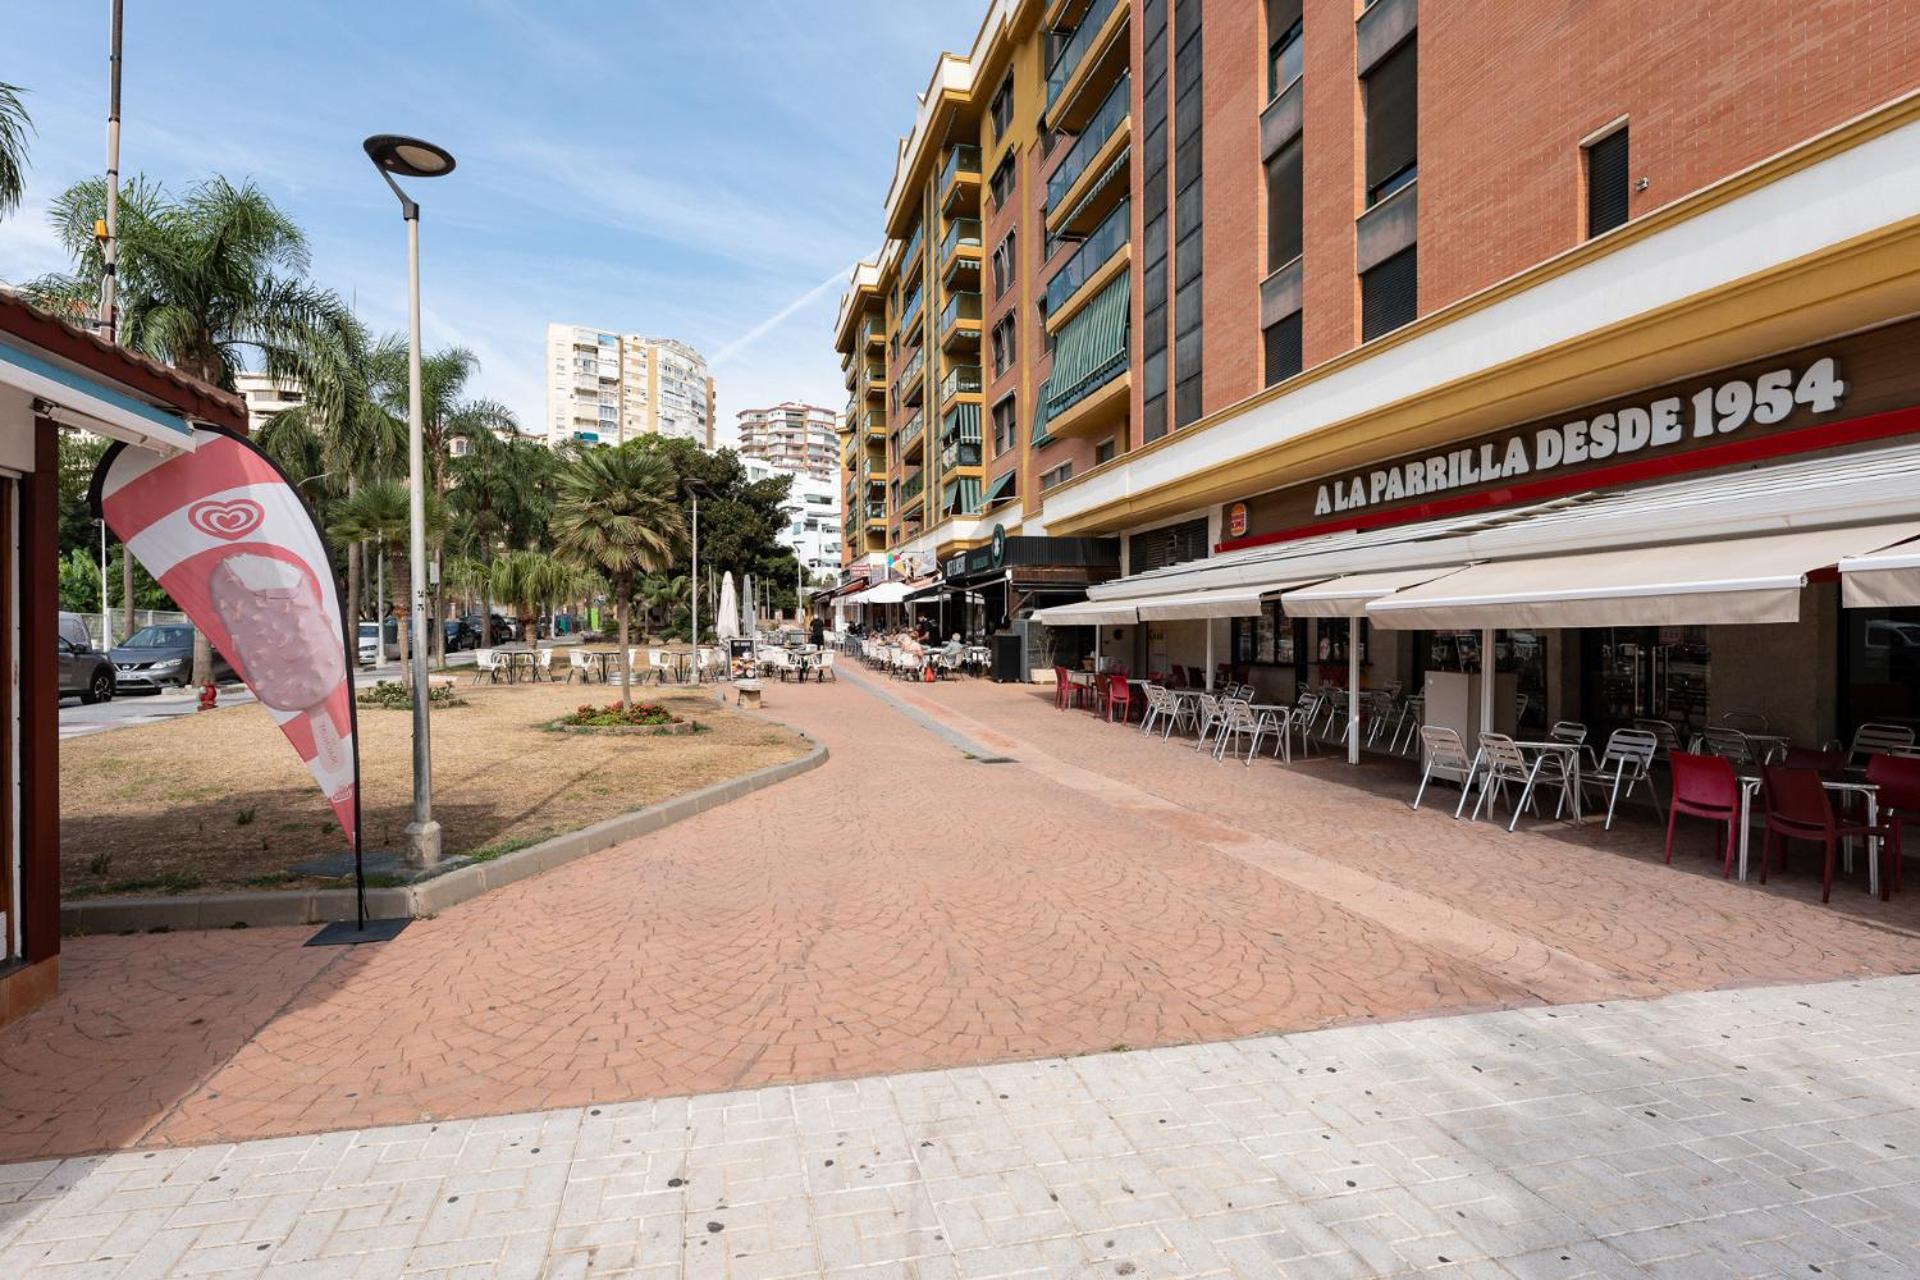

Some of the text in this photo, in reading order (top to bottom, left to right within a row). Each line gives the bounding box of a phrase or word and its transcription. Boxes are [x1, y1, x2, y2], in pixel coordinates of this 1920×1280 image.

[1314, 357, 1844, 516] A LA PARRILLA DESDE 1954
